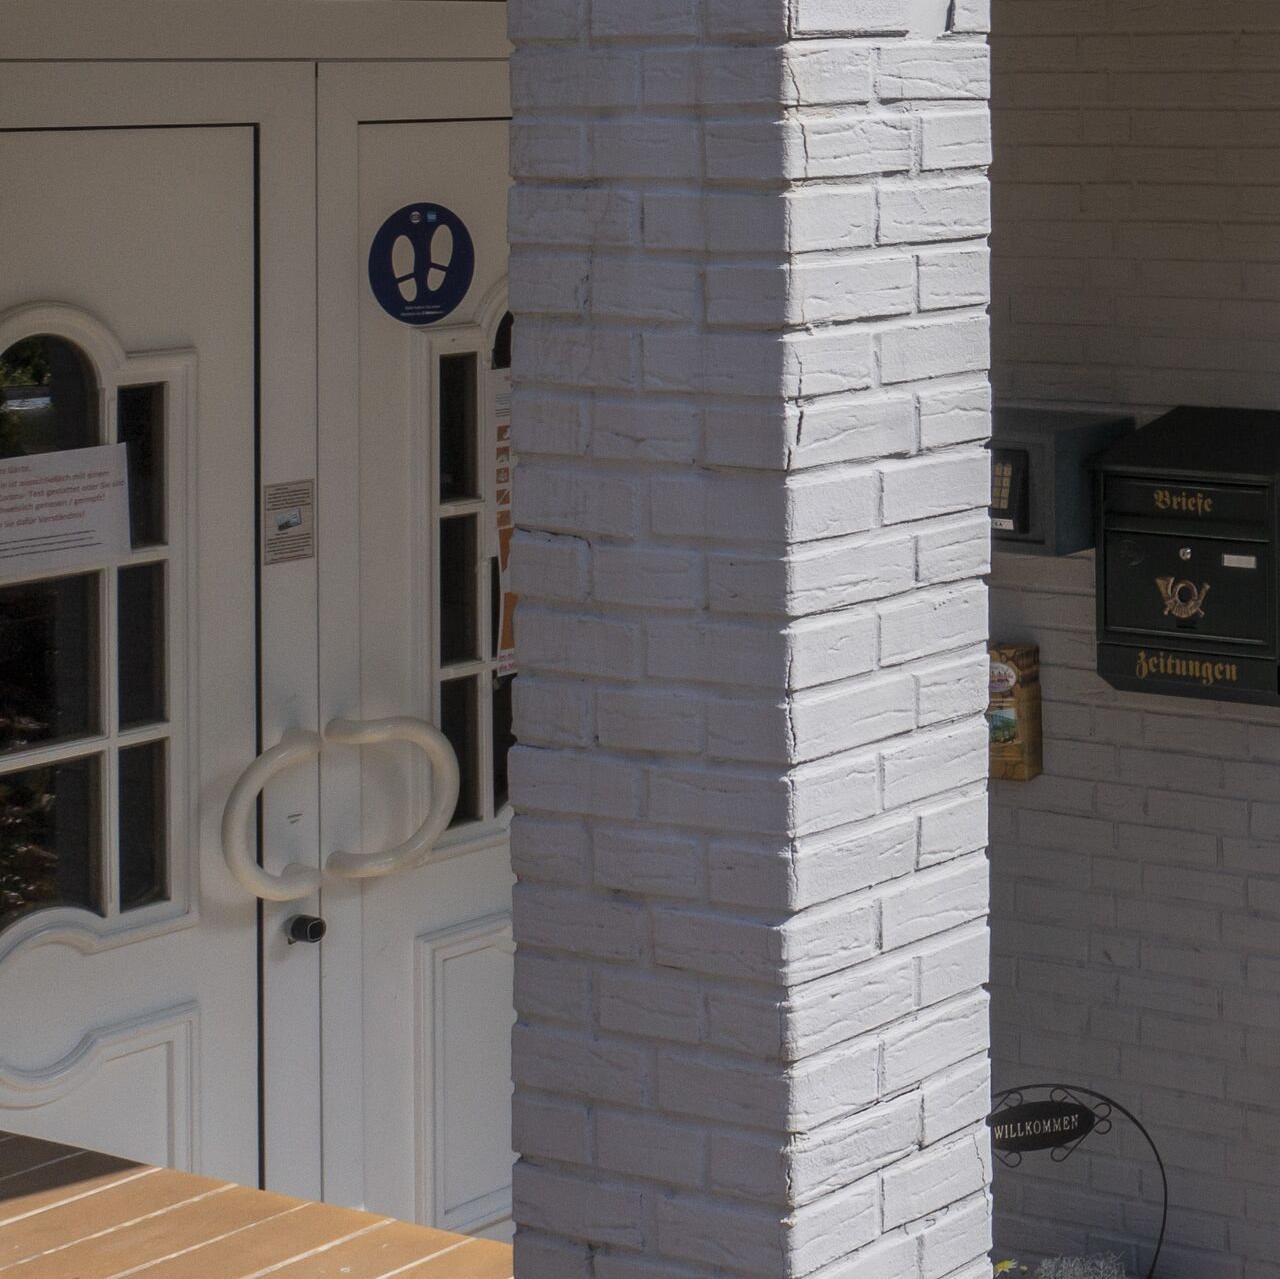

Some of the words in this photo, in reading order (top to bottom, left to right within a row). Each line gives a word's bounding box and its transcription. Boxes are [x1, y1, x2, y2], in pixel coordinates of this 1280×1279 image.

[1153, 489, 1213, 516] Briefe
[1135, 650, 1239, 686] Zeitungen
[994, 1113, 1080, 1140] WILLKOMMEN
